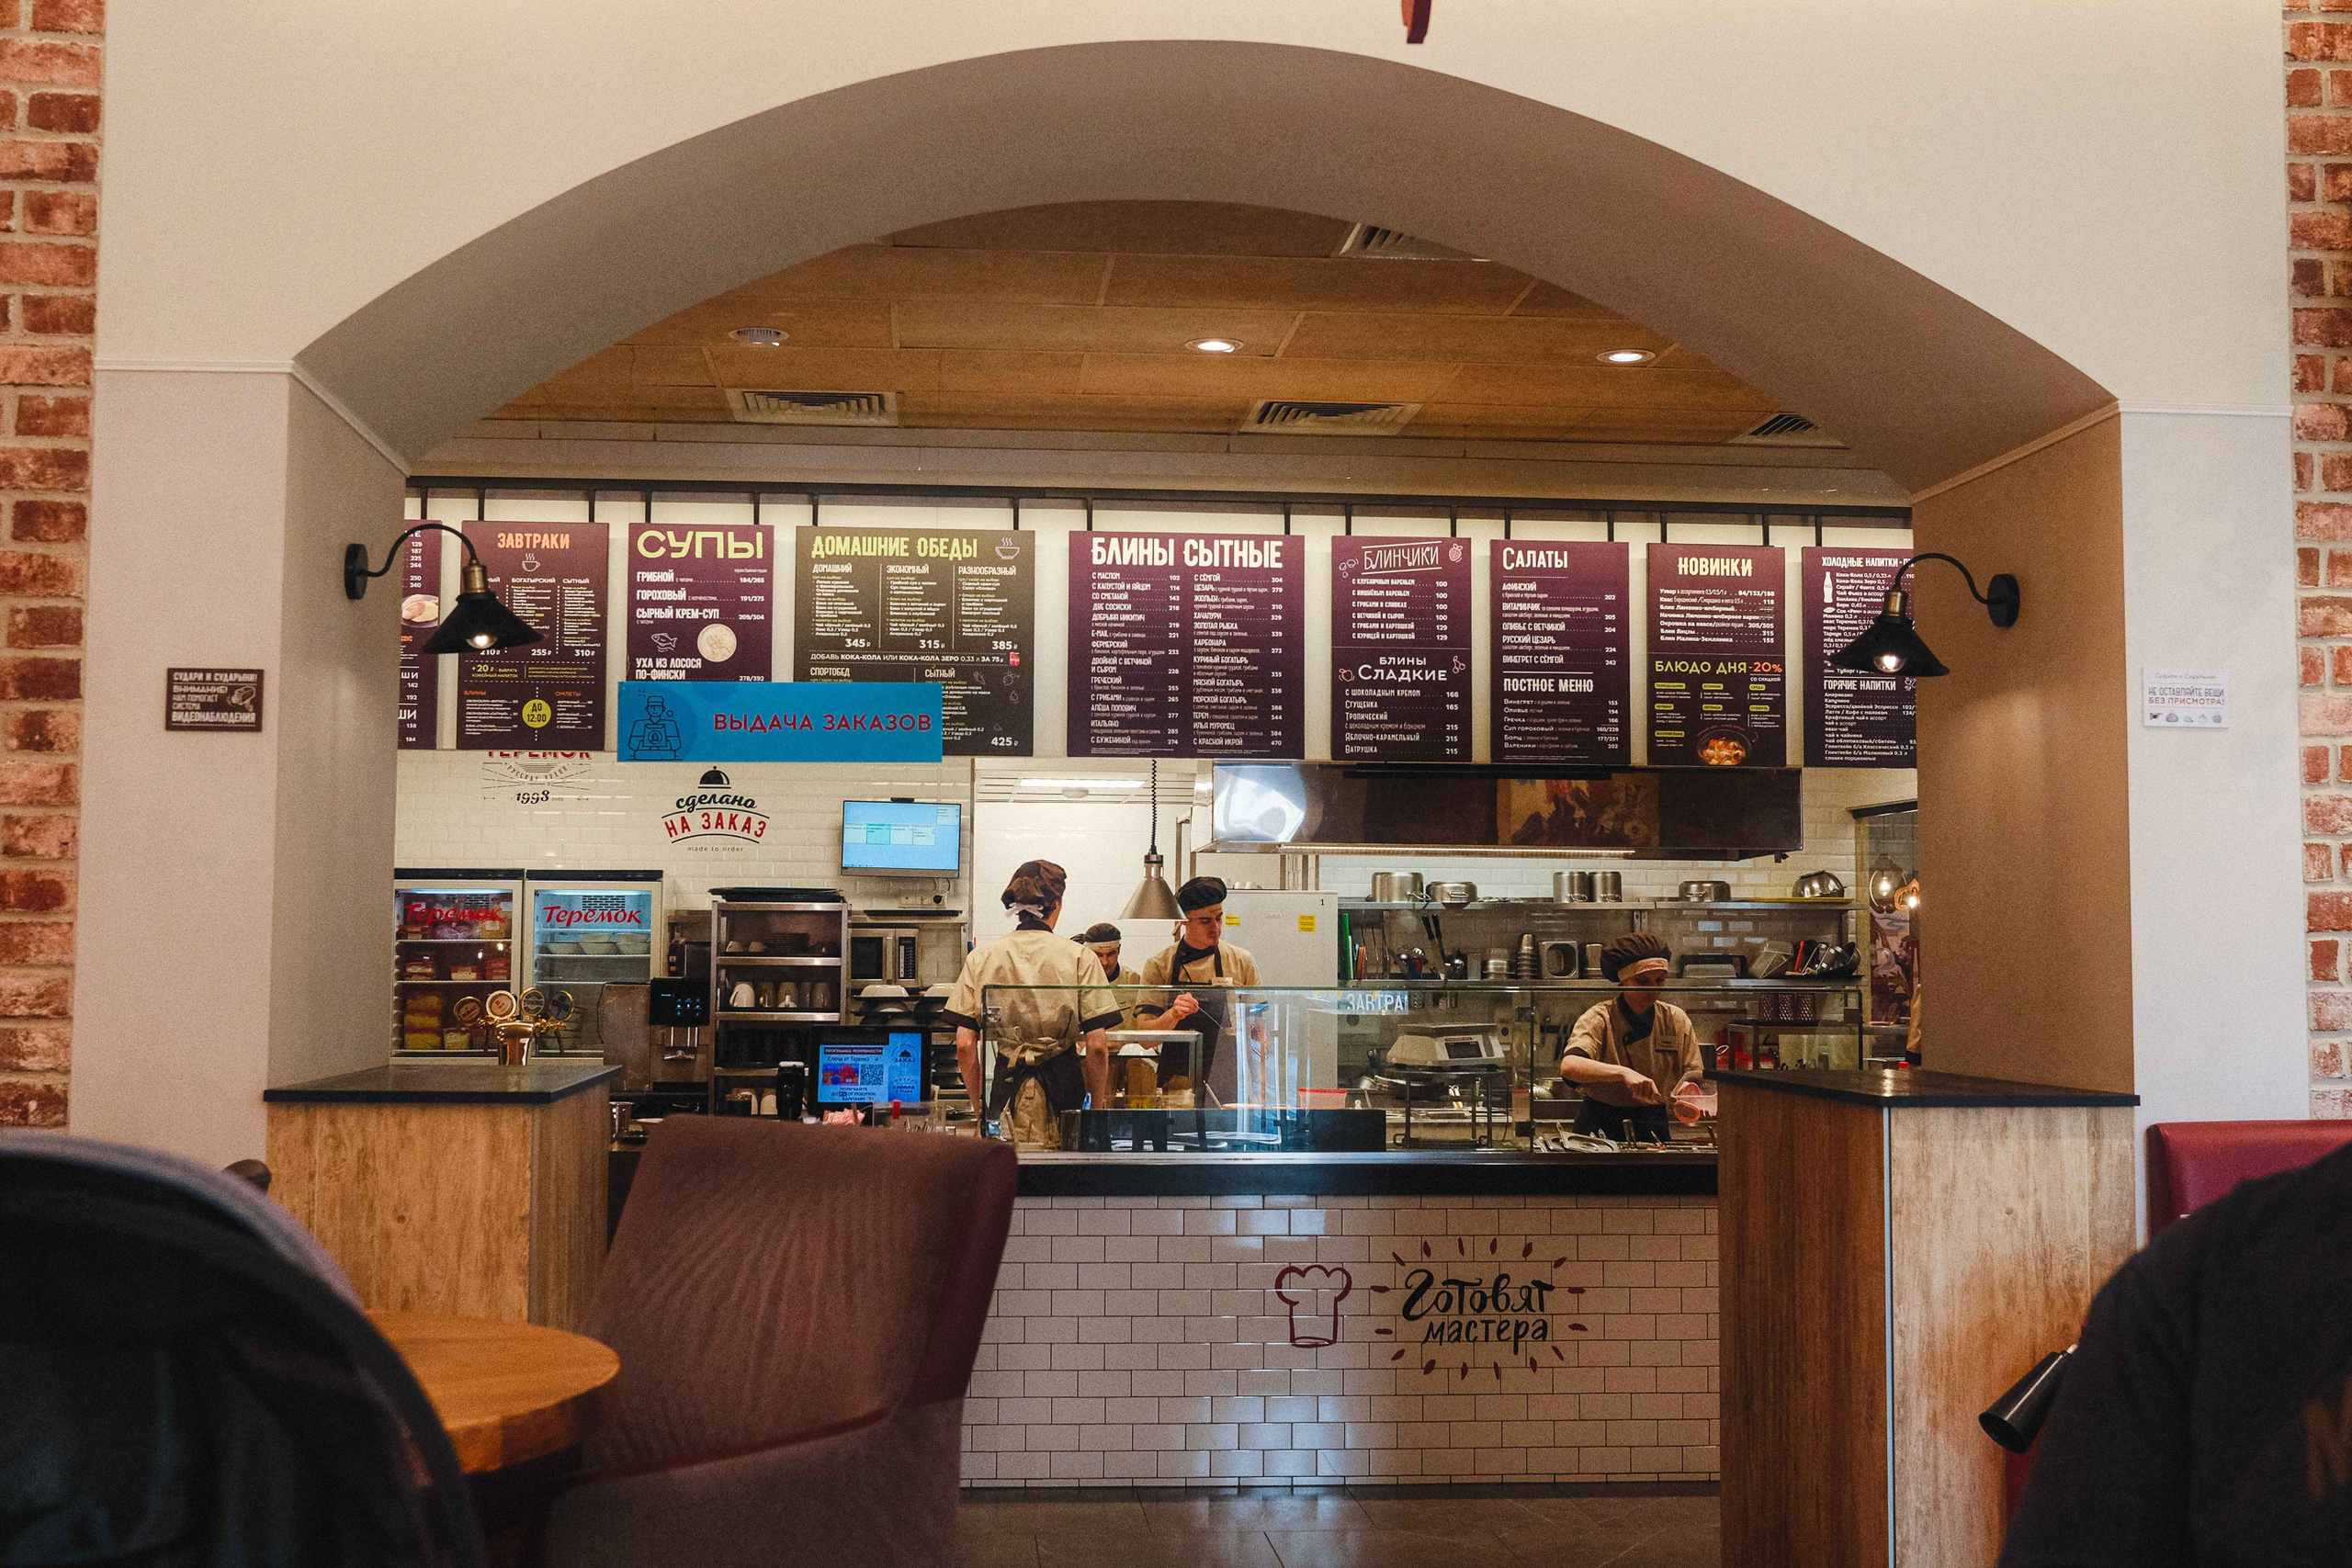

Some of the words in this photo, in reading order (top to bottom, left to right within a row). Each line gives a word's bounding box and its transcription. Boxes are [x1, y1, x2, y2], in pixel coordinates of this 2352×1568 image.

[498, 533, 570, 549] ЗАВТРАКИ
[637, 530, 763, 559] СУПЫ
[811, 535, 909, 559] ДОМАШНИЕ
[917, 537, 977, 561] ОБЕДЫ
[1091, 537, 1175, 566] БЛИНЫ
[1183, 539, 1283, 568] СЫТНЫЕ
[1364, 546, 1439, 570] БЛИНЧИКИ
[1822, 557, 1863, 568] ХОЛОДНЫЕ
[1865, 558, 1898, 567] НАПИТКИ
[812, 563, 852, 573] ДОМАШНИЙ
[886, 564, 929, 574] ЭКОНОМНЫЙ
[958, 566, 1016, 575] РАЗНООБРАЗНЫЙ
[1678, 557, 1753, 577] НОВИНКИ
[636, 569, 674, 582] ГРИБНОЙ
[1199, 573, 1220, 582] СЁМГОЙ
[1098, 582, 1125, 590] КАПУСТОЙ
[1502, 582, 1537, 591] АФИНСКИЙ
[636, 588, 686, 600] ГОРОХОВЫЙ
[1502, 603, 1541, 611] ВИТАМИНЧИК
[636, 606, 673, 619] СЫРНЫЙ
[676, 608, 719, 619] КРЕМ-СУП
[1534, 622, 1565, 631] ВЕТЧИНОЙ
[1503, 634, 1531, 643] РУССКИЙ
[1091, 640, 1128, 648] ФЕРМЕРСКИЙ
[636, 658, 654, 668] УХА
[656, 658, 667, 668] ИЗ
[670, 658, 702, 668] ЛОСОСЯ
[1091, 657, 1117, 665] ДВОЙНОЙ
[1124, 657, 1152, 665] ВЕТЧИНОЙ
[1193, 655, 1219, 663] КУРИНЫЙ
[1379, 657, 1426, 665] БЛИНЫ
[1540, 655, 1564, 664] СЁМГОЙ
[810, 668, 850, 677] СПОРТОБЕД
[1655, 661, 1711, 674] БЛЮДО
[1716, 662, 1747, 674] ДНЯ
[1748, 662, 1782, 673] -20%
[173, 672, 203, 681] СУДАРИ
[214, 673, 258, 682] СУДАРЫНИ!
[636, 669, 686, 680] ПО-ФИНСКИ
[925, 668, 955, 678] СЫТНЫЙ
[173, 685, 228, 694] ВНИМАНИЕ!
[1504, 678, 1555, 692] ПОСТНОЕ
[1558, 679, 1594, 692] МЕНЮ
[1824, 680, 1857, 690] ГОРЯЧИЕ
[1860, 680, 1896, 691] НАПИТКИ
[2148, 687, 2157, 695] НЕ
[2159, 686, 2202, 696] ОСТАВЛЯЙТЕ
[2205, 688, 2224, 697] ВЕЩИ
[532, 703, 542, 712] ДО
[172, 711, 256, 723] ВИДЕОНАБЛЮДЕНИЯ
[527, 713, 546, 722] 12:00
[714, 714, 814, 733] ВЫДАЧА
[822, 714, 931, 731] ЗАКАЗОВ
[1096, 736, 1131, 744] БУЖЕНИНОЙ
[676, 794, 758, 813] сделано
[664, 816, 691, 838] НА
[701, 812, 767, 837] ЗАКАЗ
[403, 903, 505, 926] Теремок
[542, 905, 642, 926] Теремок
[1423, 1318, 1548, 1355] мастера
